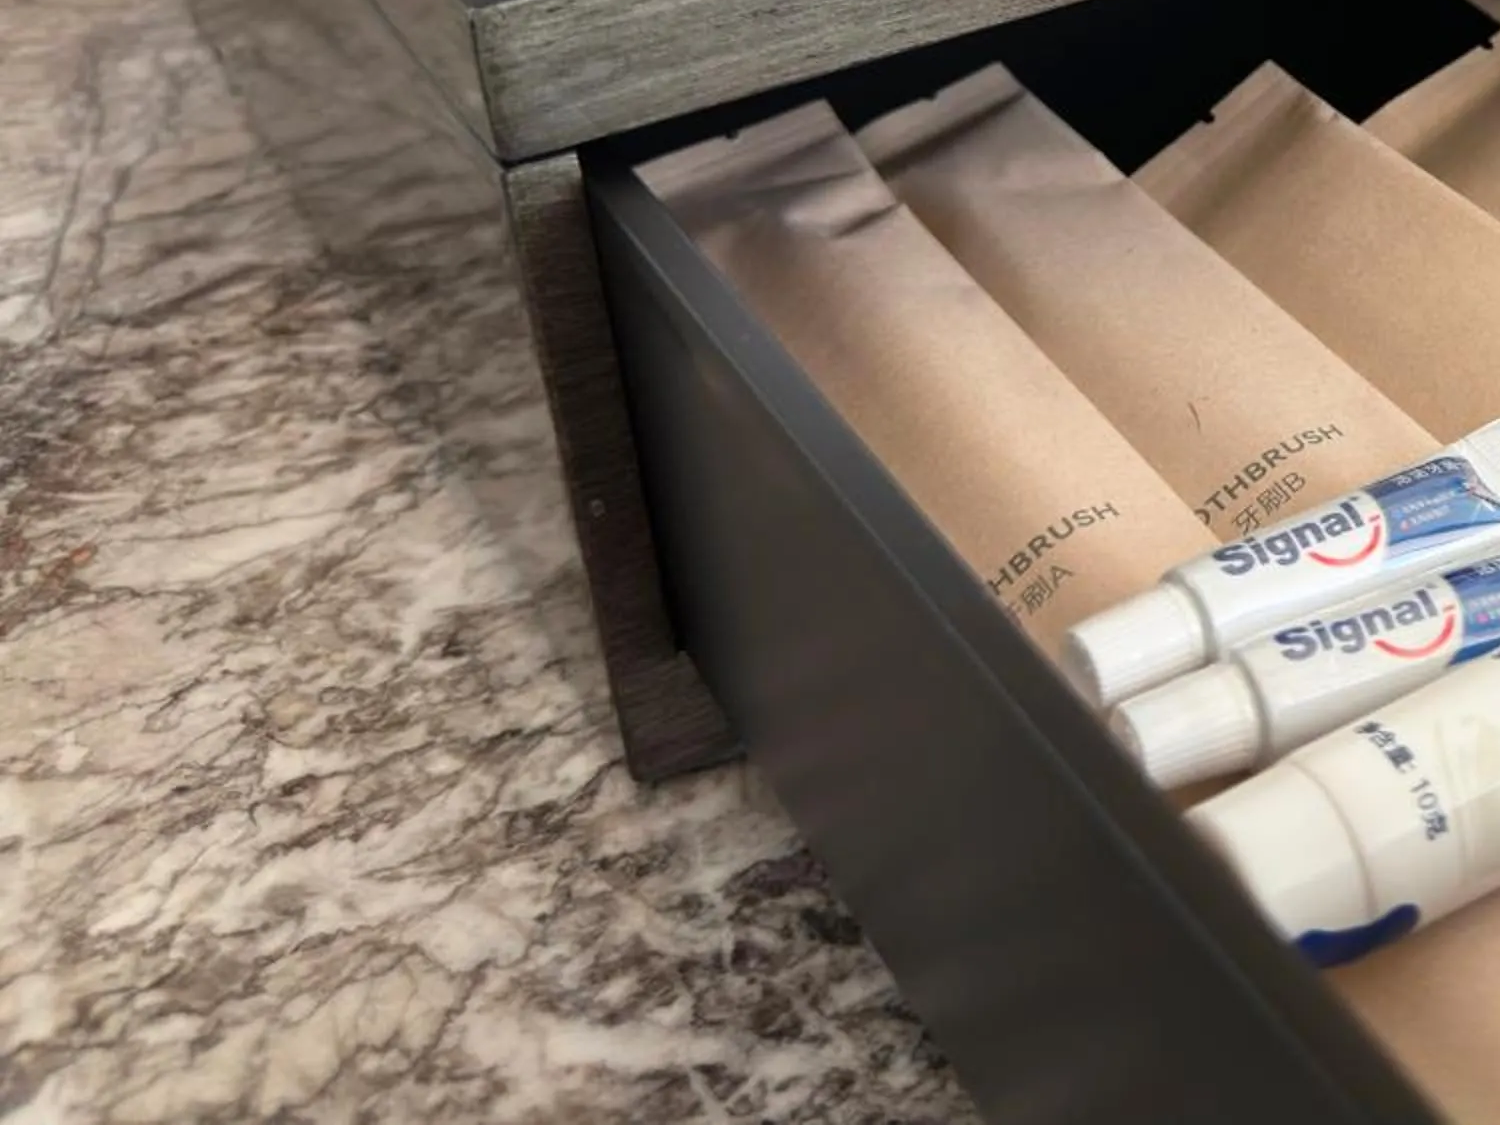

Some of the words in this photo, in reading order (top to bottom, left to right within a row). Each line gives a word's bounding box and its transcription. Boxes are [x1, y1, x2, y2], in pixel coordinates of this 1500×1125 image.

[1212, 498, 1365, 577] Signal
[1231, 471, 1307, 536] 牙刷B
[1272, 587, 1440, 661] Signal
